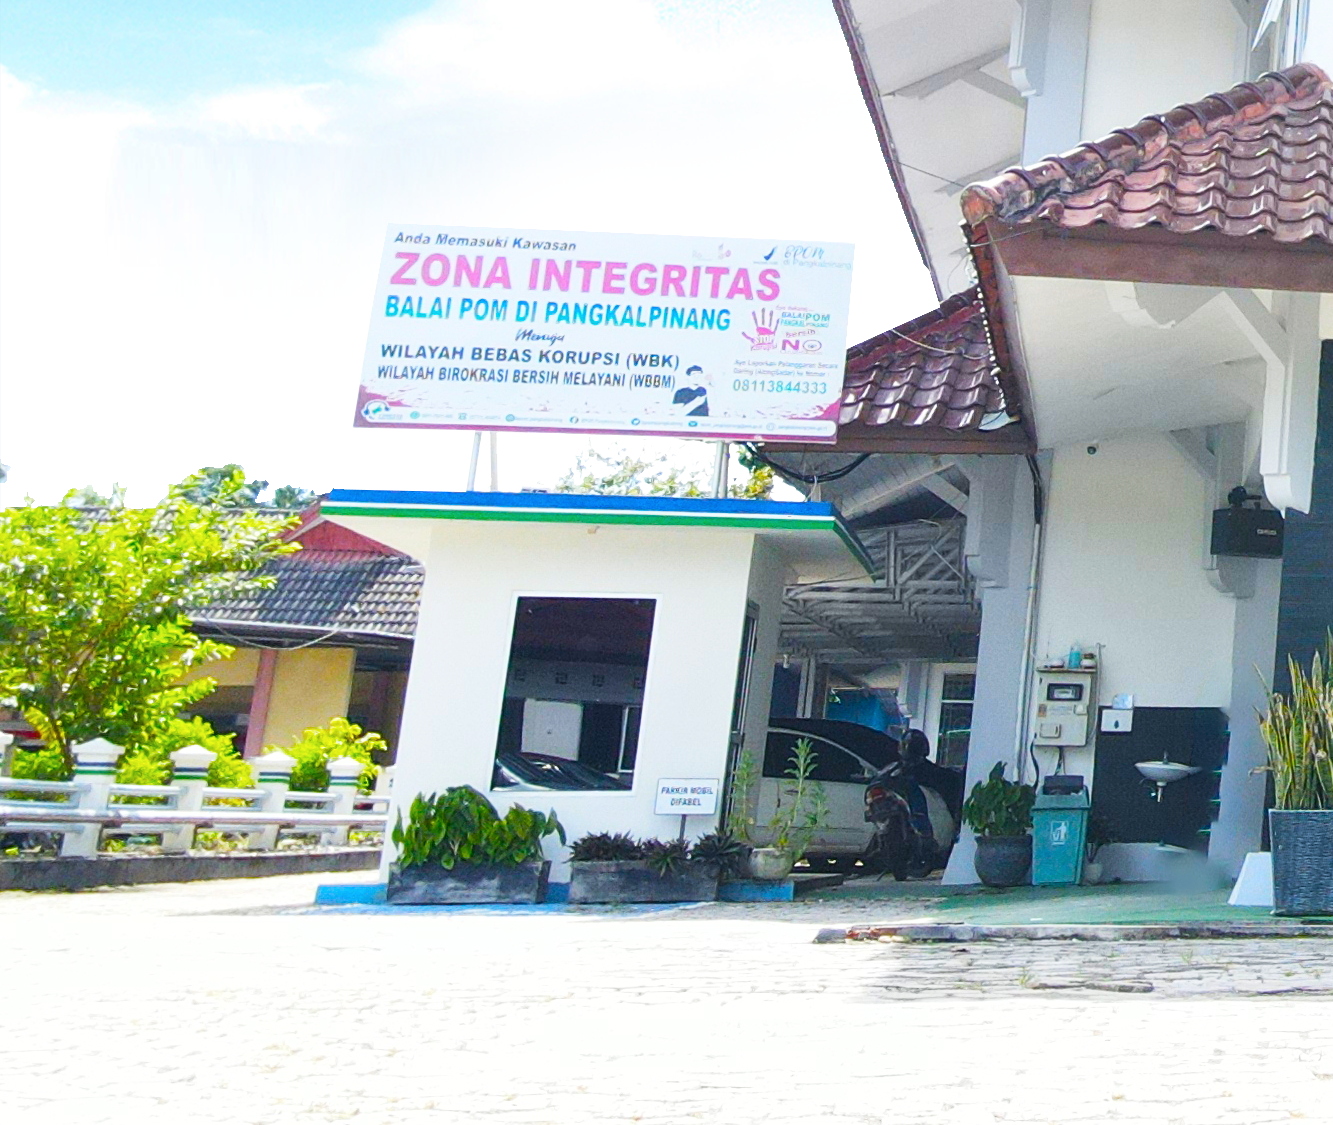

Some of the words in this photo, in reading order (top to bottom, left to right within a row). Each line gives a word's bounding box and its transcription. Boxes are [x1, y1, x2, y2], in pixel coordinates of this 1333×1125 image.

[394, 232, 431, 244] Anda
[435, 234, 508, 248] Memasuki
[512, 237, 576, 251] Kawasan
[389, 251, 512, 290] ZONA
[528, 258, 781, 302] INTEGRITAS
[385, 295, 452, 319] BALAI
[459, 298, 508, 321] POM
[515, 300, 537, 322] DI
[545, 301, 731, 331] PANGKALPINANG
[381, 344, 464, 360] WILAYAH
[471, 347, 532, 362] BEBAS
[539, 350, 620, 366] KORUPSI
[626, 352, 680, 371] (WBK)
[378, 365, 435, 380] WILAYAH
[438, 366, 509, 383] BIROKRASI
[512, 369, 560, 385] BERSIH
[563, 371, 626, 387] MELAYANI
[629, 373, 677, 390] (WBBM)
[733, 379, 827, 394] 08113844333
